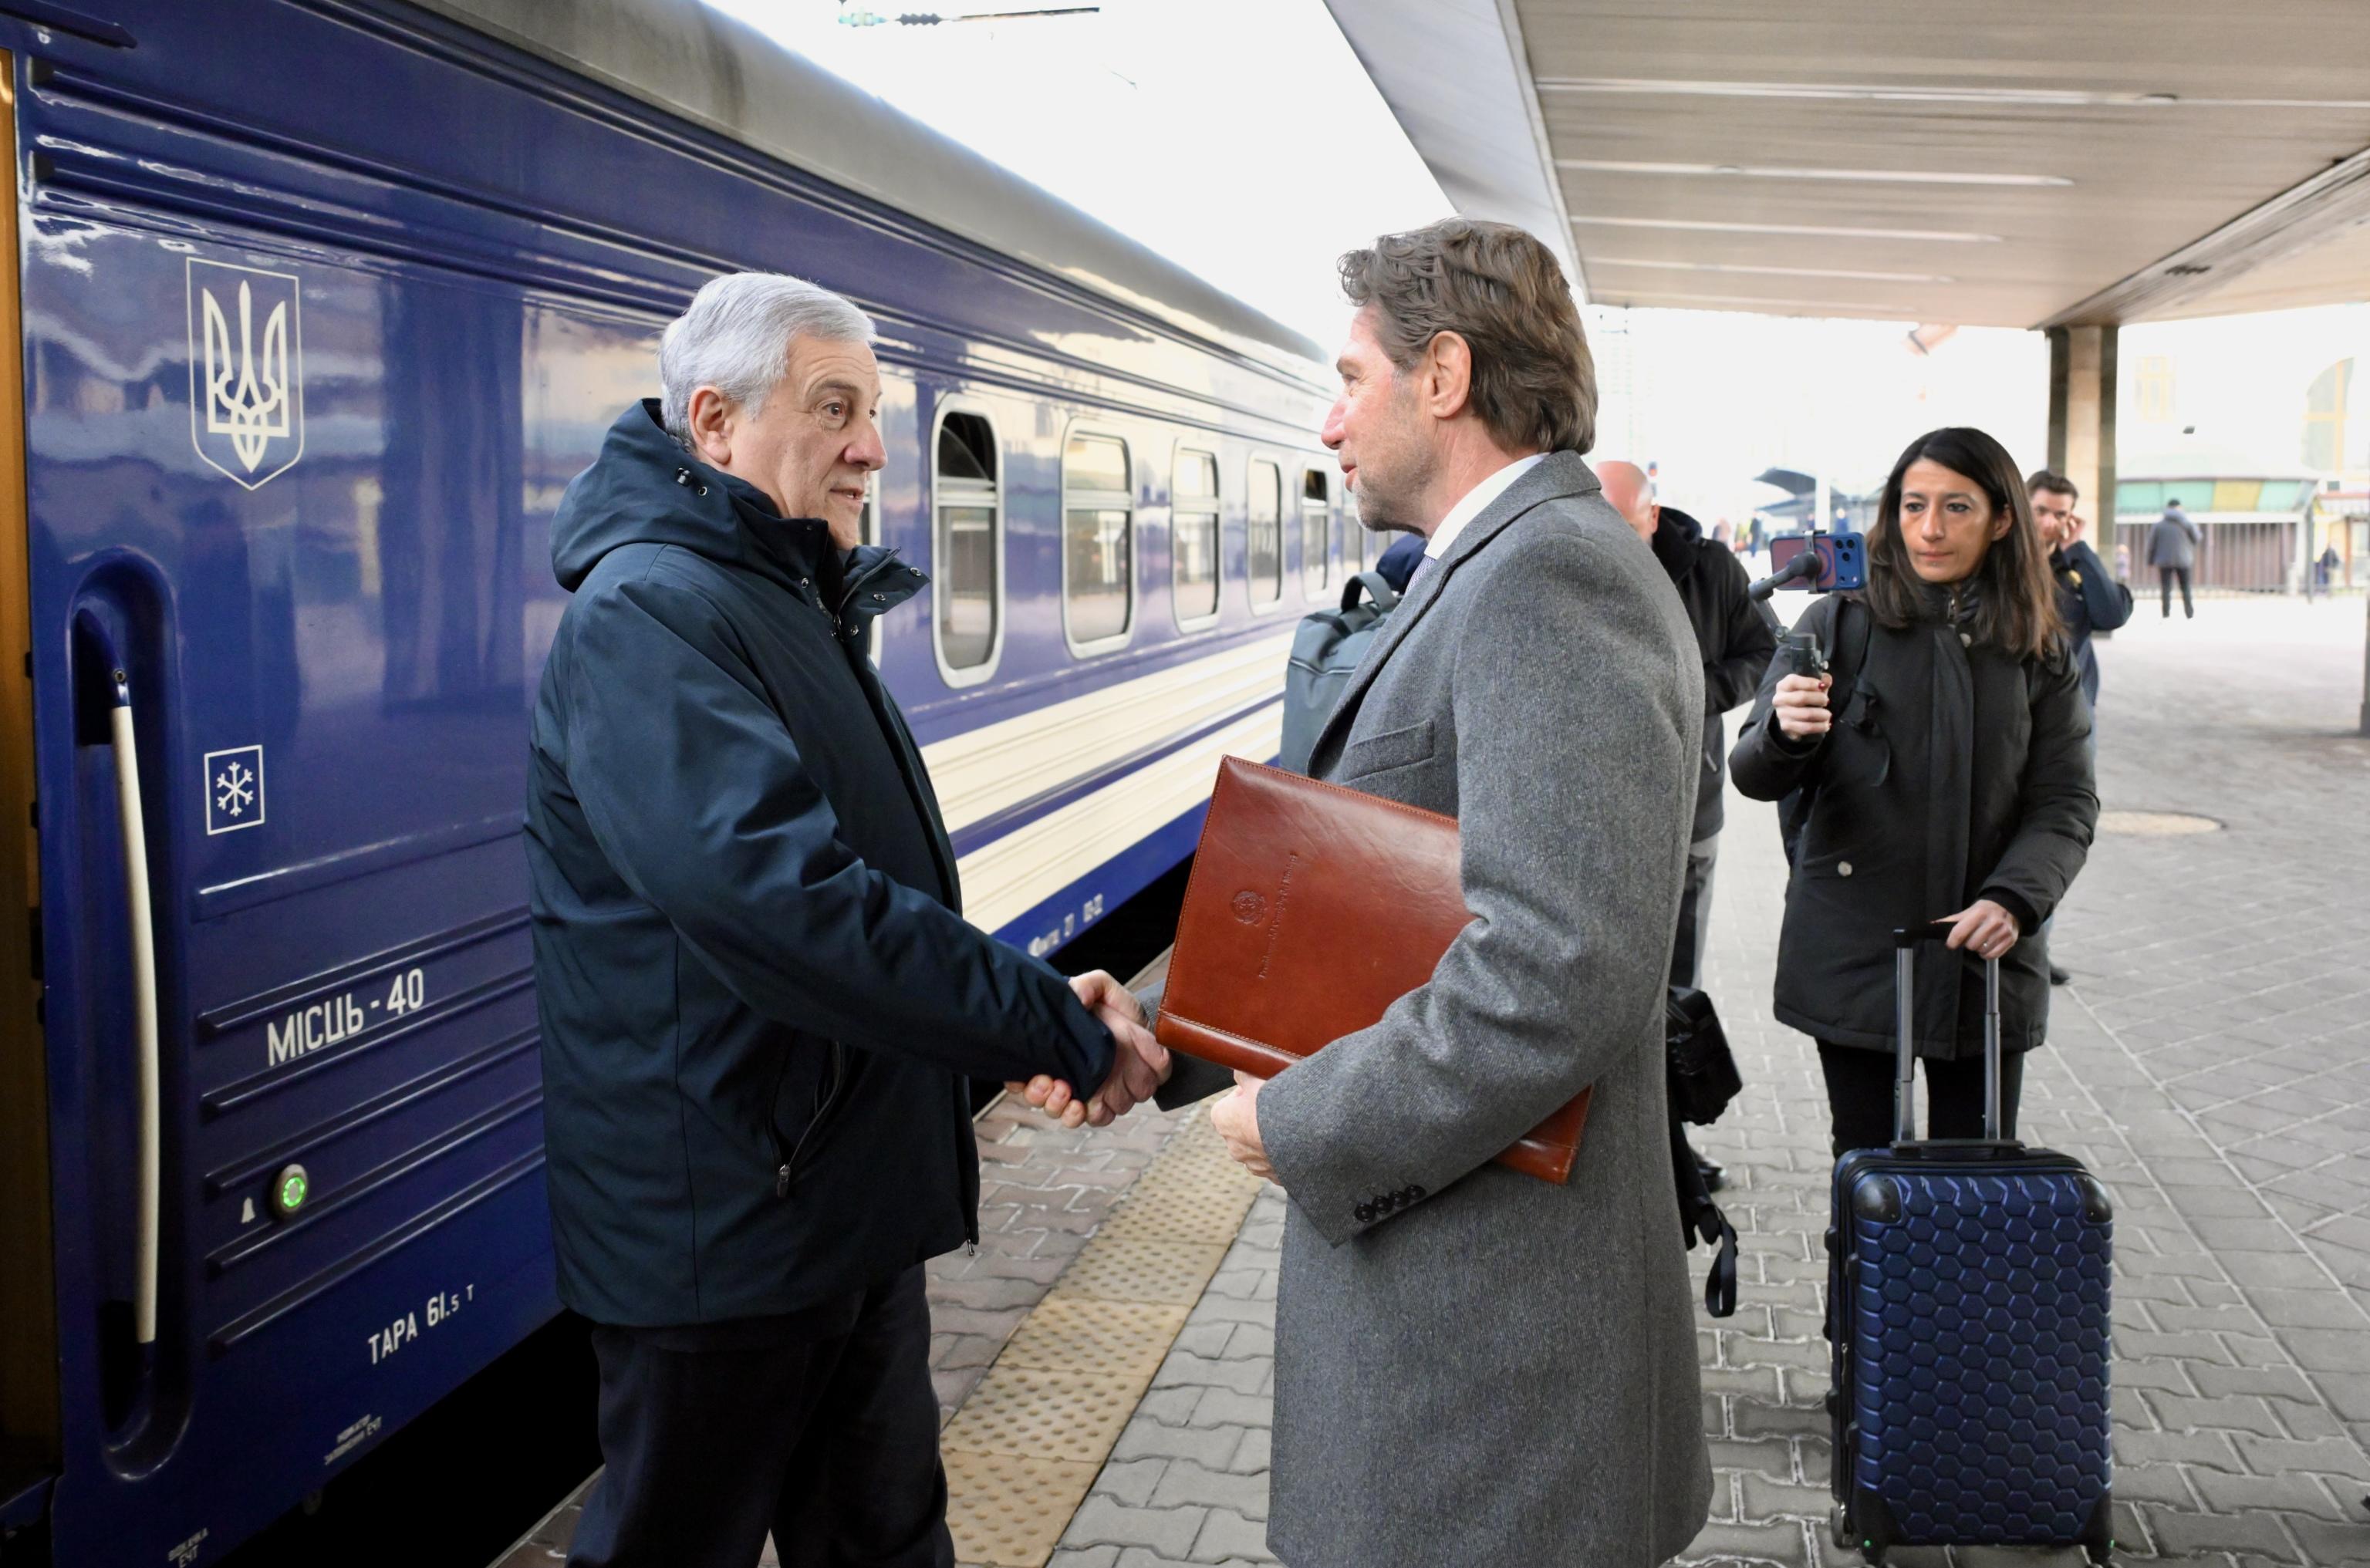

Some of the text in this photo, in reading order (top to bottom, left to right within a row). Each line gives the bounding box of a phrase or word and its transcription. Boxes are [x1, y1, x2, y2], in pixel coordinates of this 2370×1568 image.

[267, 993, 364, 1067] МІСЦЬ
[387, 968, 424, 1015] 40
[367, 1311, 418, 1365] ТАРА
